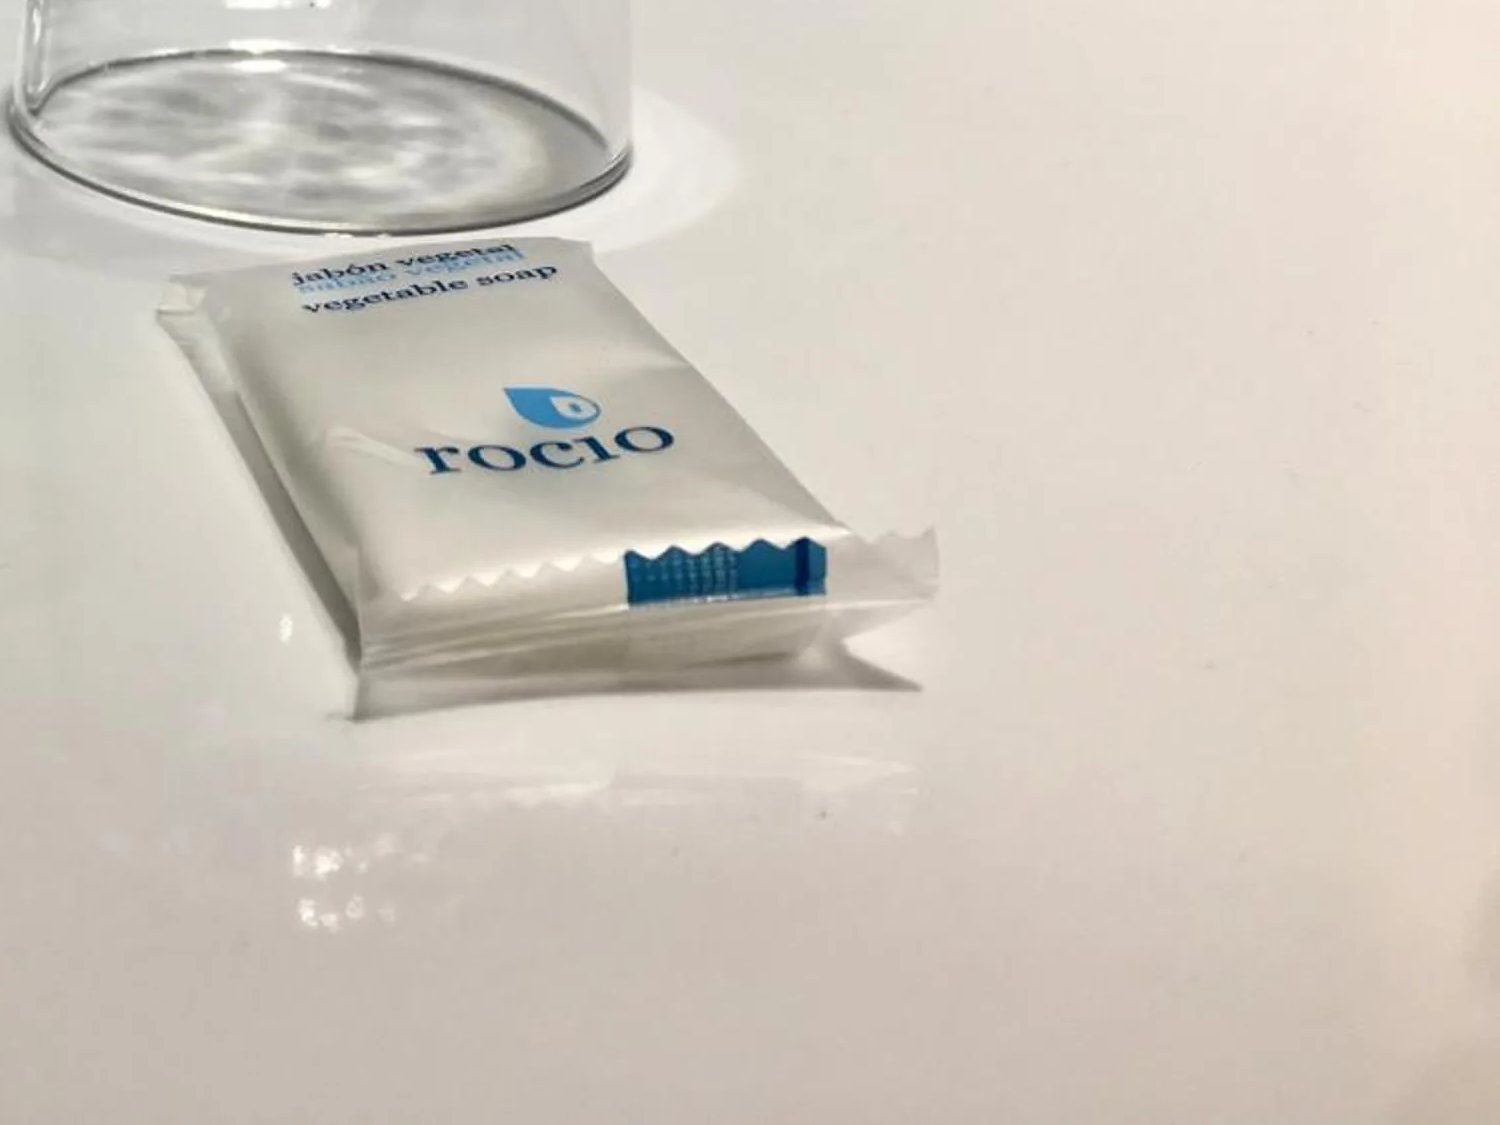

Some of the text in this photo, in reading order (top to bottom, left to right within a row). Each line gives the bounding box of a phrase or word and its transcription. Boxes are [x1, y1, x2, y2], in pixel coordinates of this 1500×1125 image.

[396, 243, 517, 267] vegetal
[301, 265, 559, 313] vegetable soap
